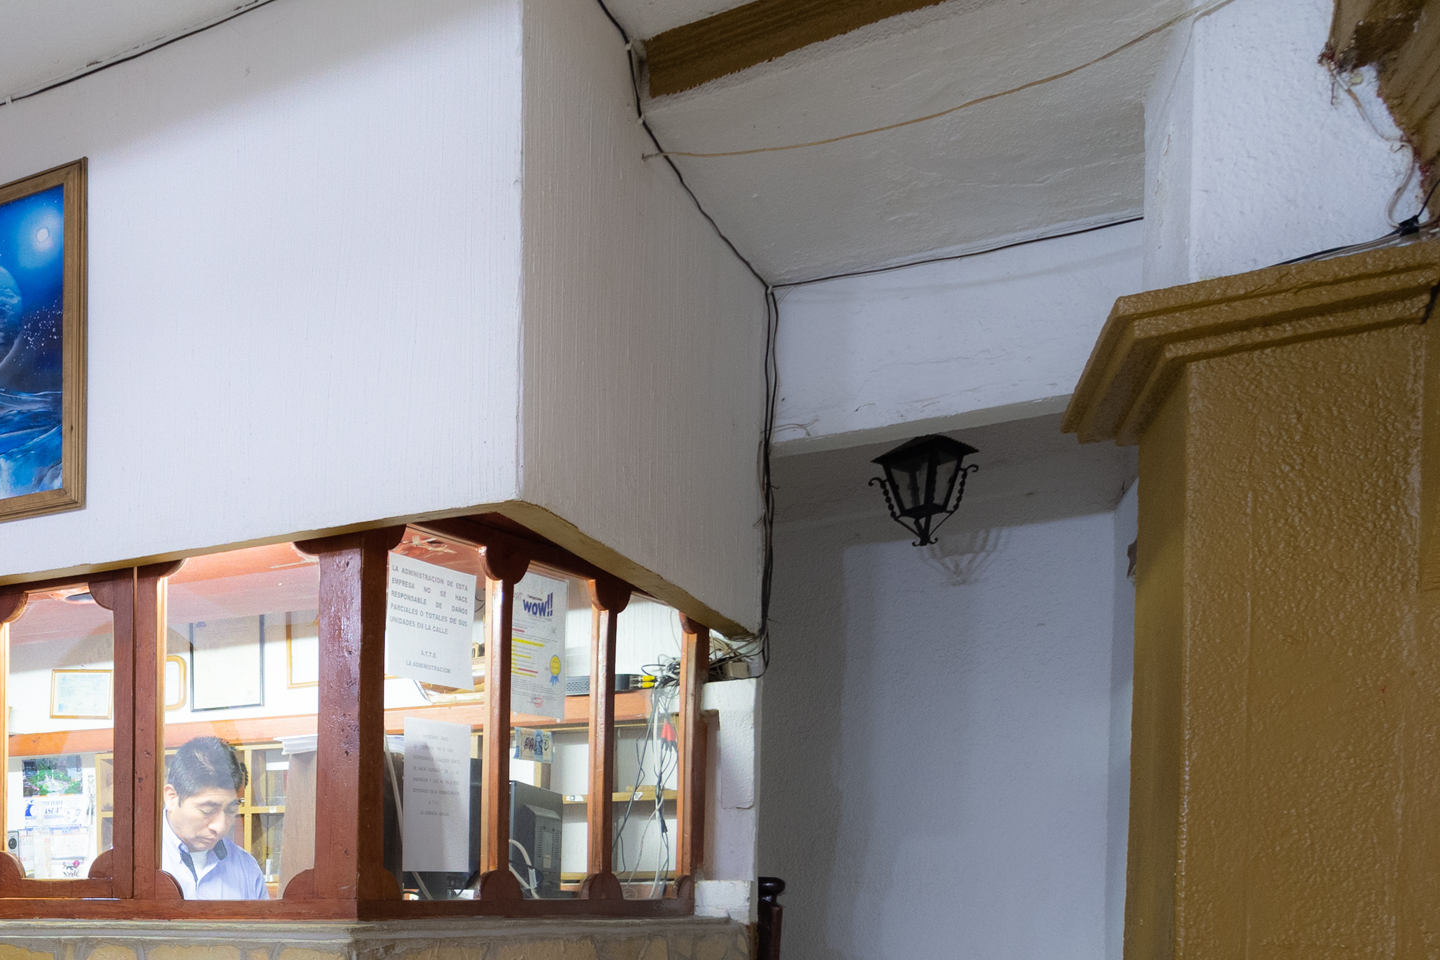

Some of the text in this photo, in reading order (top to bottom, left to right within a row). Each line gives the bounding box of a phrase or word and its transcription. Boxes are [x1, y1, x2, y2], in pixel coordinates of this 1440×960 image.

[401, 568, 444, 584] ADMINISTRACION
[447, 580, 453, 588] DE
[456, 583, 468, 591] ESTA
[391, 590, 426, 605] RESPONSABLE
[392, 577, 414, 589] EMPRESA
[455, 594, 468, 603] HACE
[390, 603, 418, 615] PARCIALES
[425, 611, 447, 622] TOTALES
[390, 616, 416, 628] UNIDADES
[432, 626, 448, 634] CALLE
[413, 662, 451, 674] ADMINISTRACION
